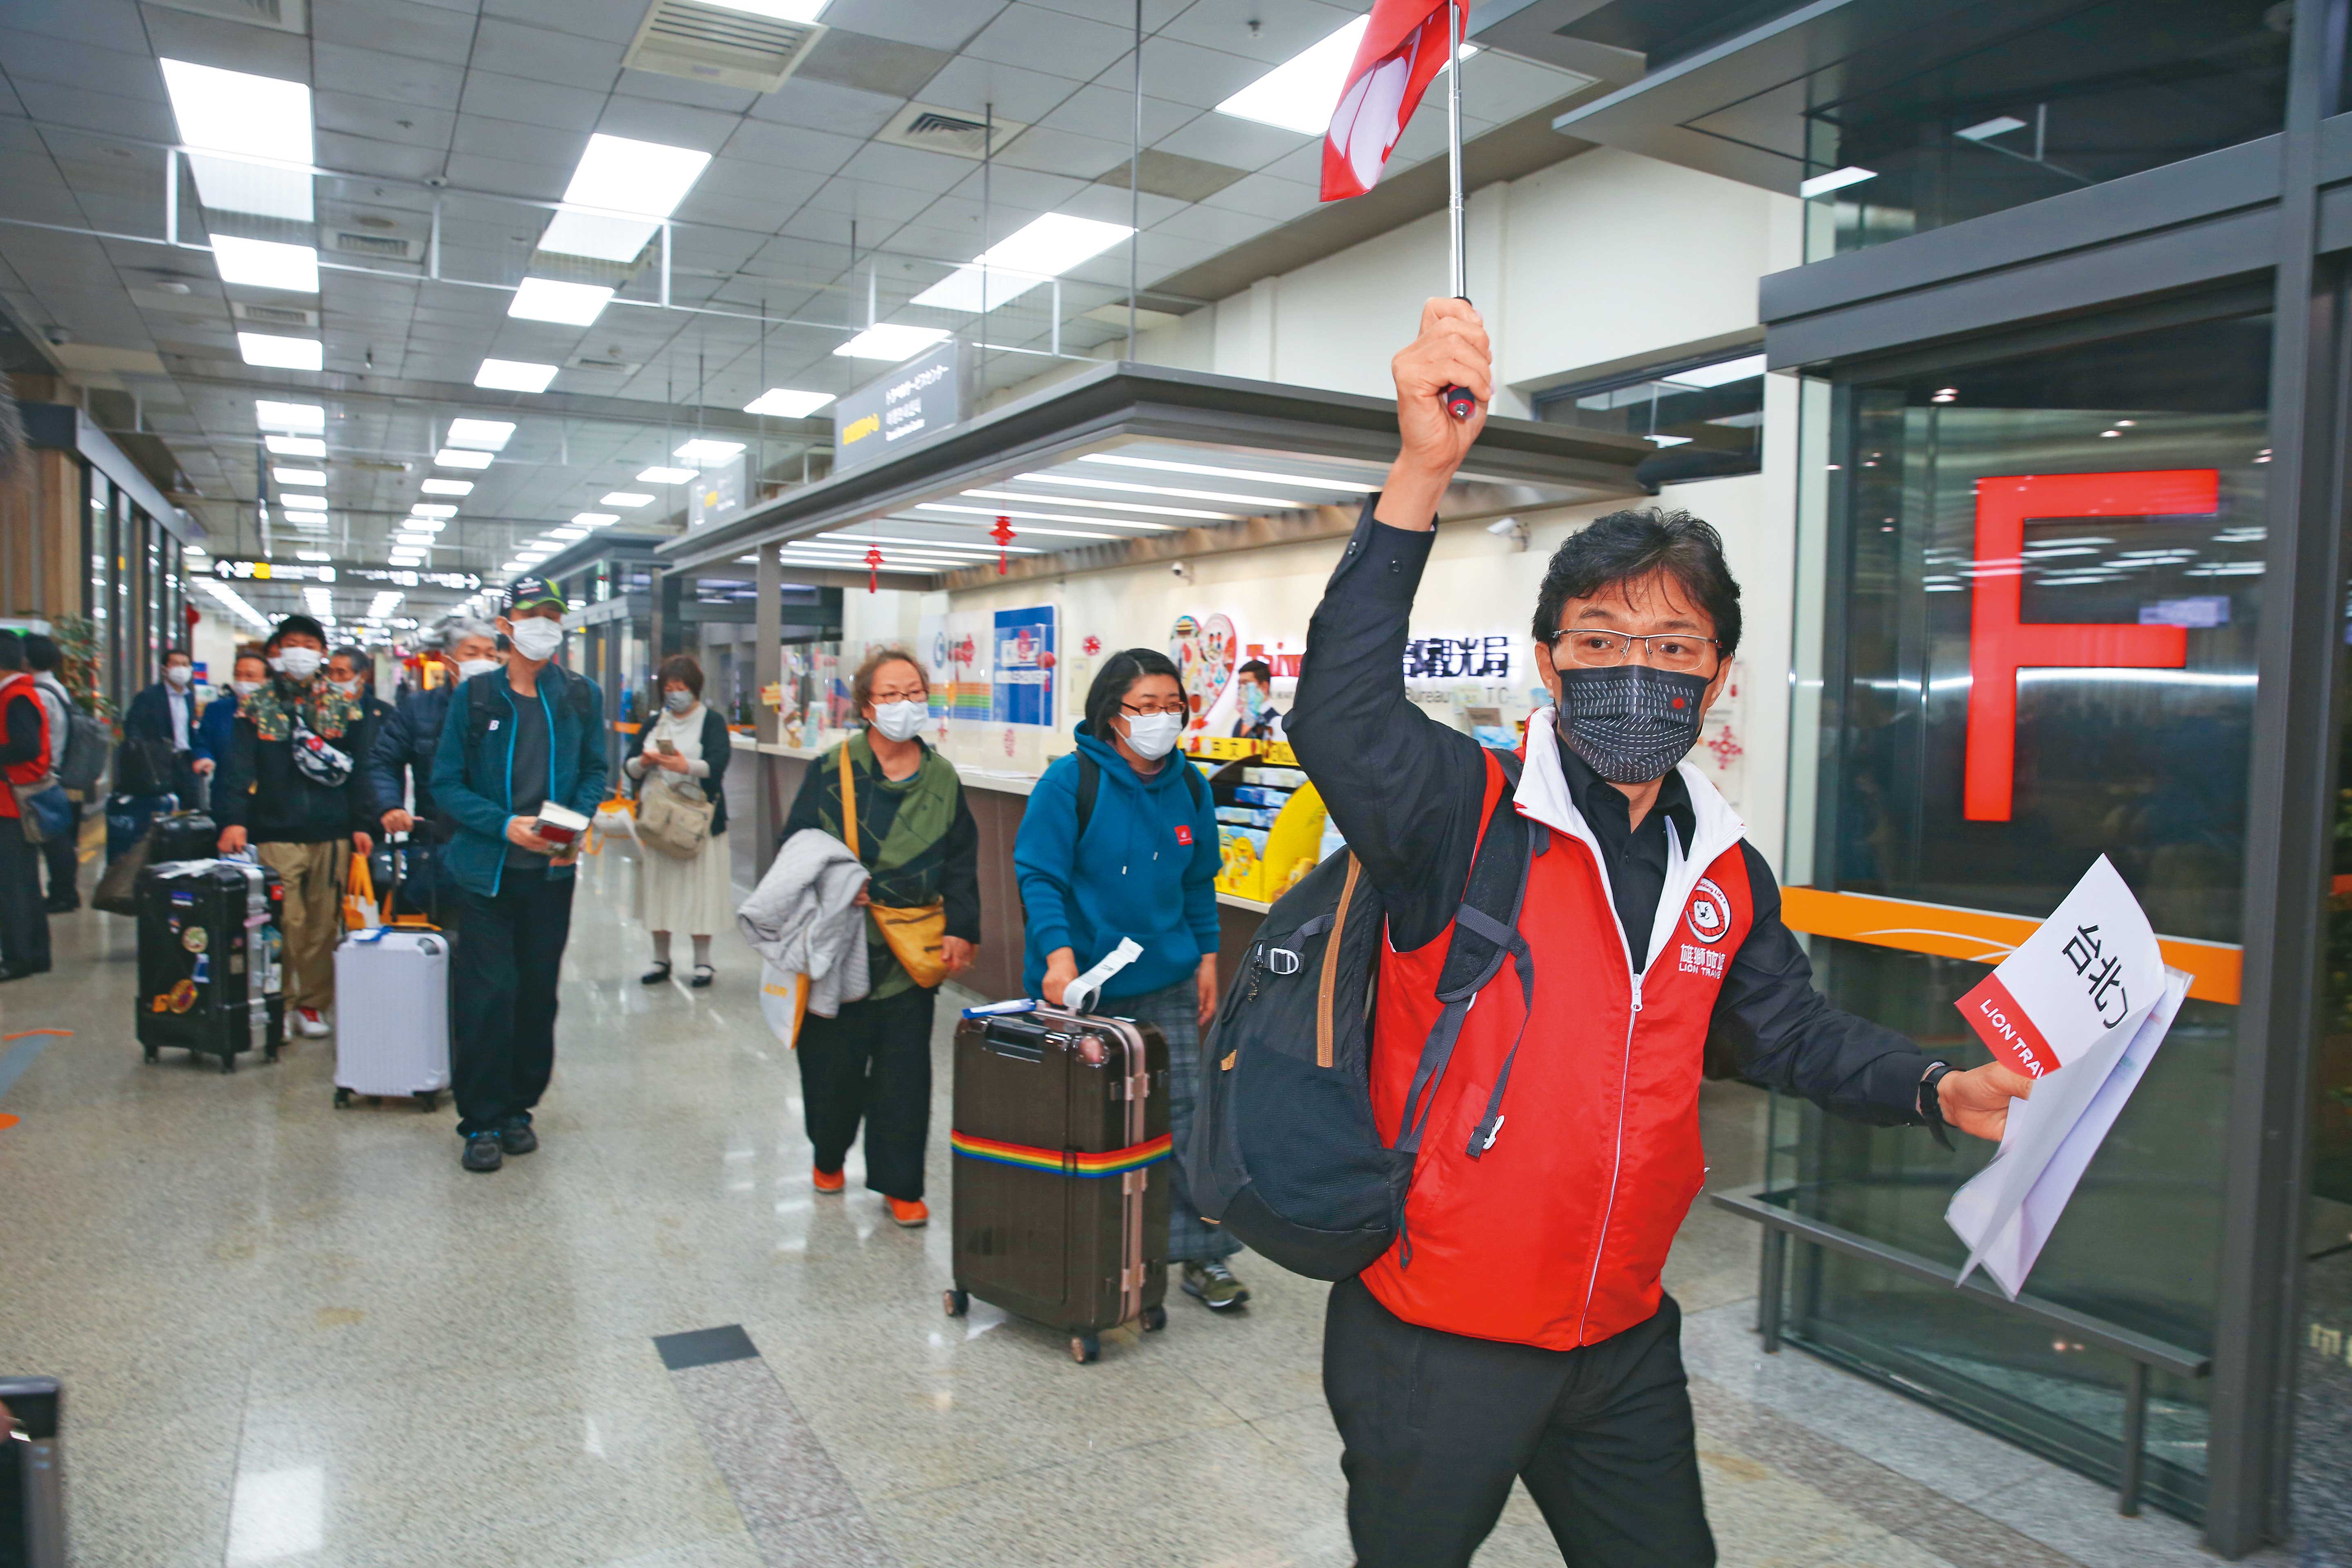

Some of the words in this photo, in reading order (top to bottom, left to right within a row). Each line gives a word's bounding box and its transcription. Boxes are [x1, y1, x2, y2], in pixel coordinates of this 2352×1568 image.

[1964, 469, 2218, 821] F
[1679, 962, 1699, 974] LION
[2061, 924, 2129, 1029] 台北
[1980, 998, 2017, 1041] LION
